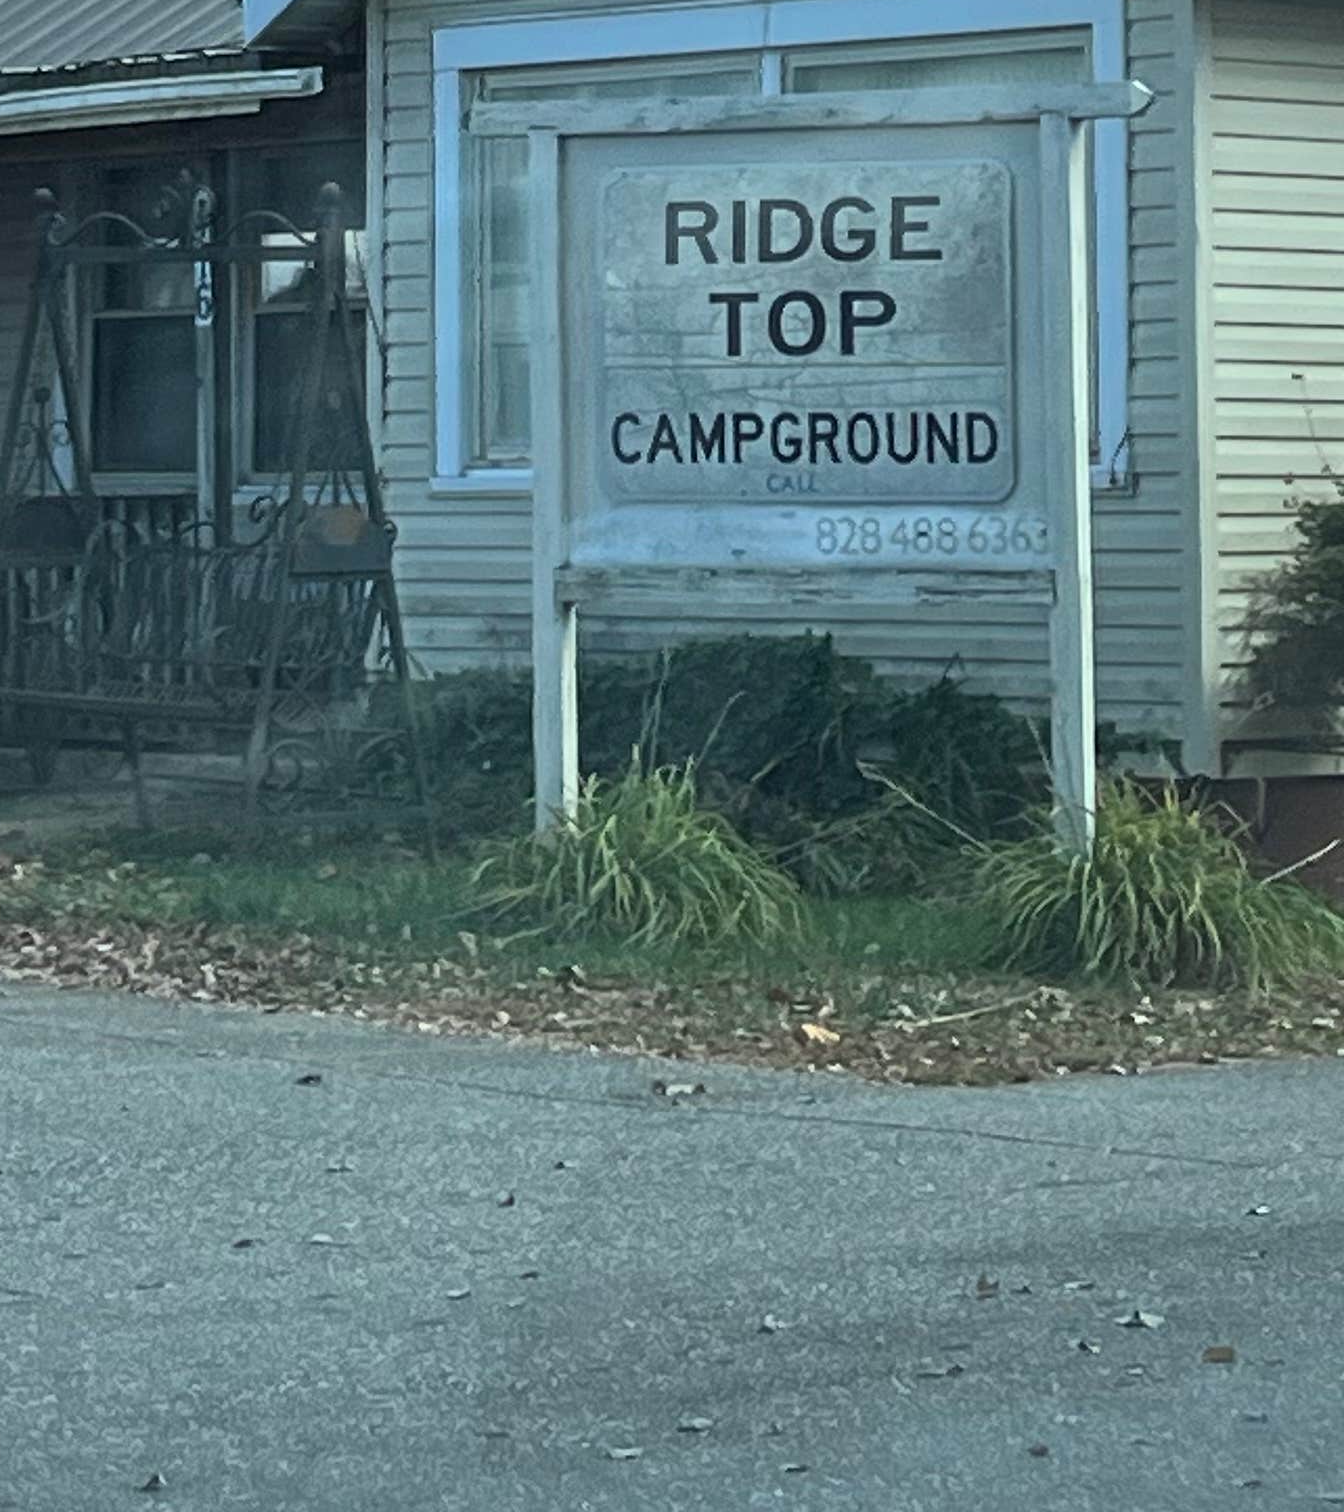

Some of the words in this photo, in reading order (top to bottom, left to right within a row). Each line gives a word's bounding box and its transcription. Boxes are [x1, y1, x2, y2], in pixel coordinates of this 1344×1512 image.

[664, 196, 943, 265] RIDGE
[709, 290, 897, 357] TOP
[611, 412, 998, 465] CAMPGROUND
[766, 473, 819, 494] CALL
[816, 516, 882, 555] 828
[890, 516, 957, 555] 488
